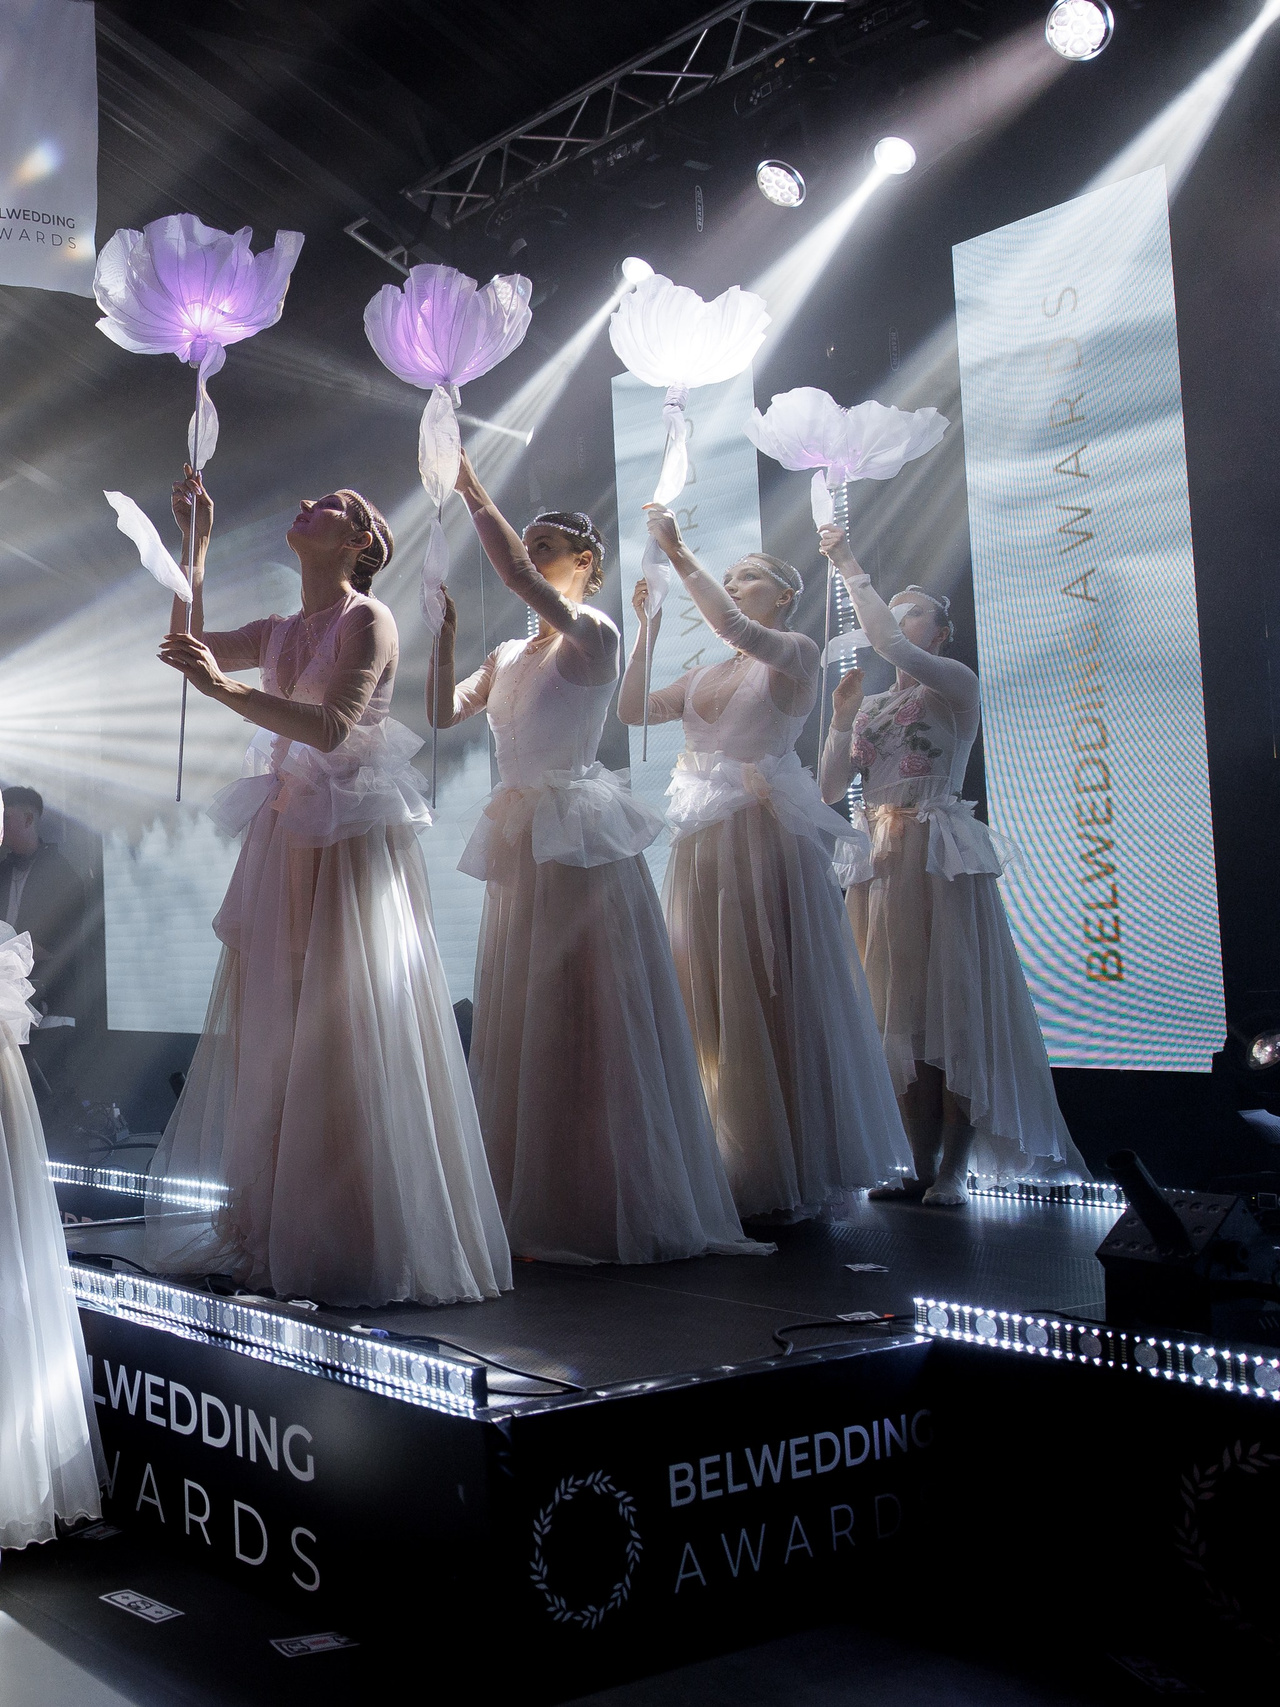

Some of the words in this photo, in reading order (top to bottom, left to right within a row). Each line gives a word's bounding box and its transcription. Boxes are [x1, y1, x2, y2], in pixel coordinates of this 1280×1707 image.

[1041, 286, 1098, 603] AWARDS
[1068, 622, 1125, 983] BELWEDDING
[87, 1354, 315, 1482] LWEDDING
[668, 1408, 934, 1509] BELWEDDING
[674, 1482, 930, 1595] AWARD
